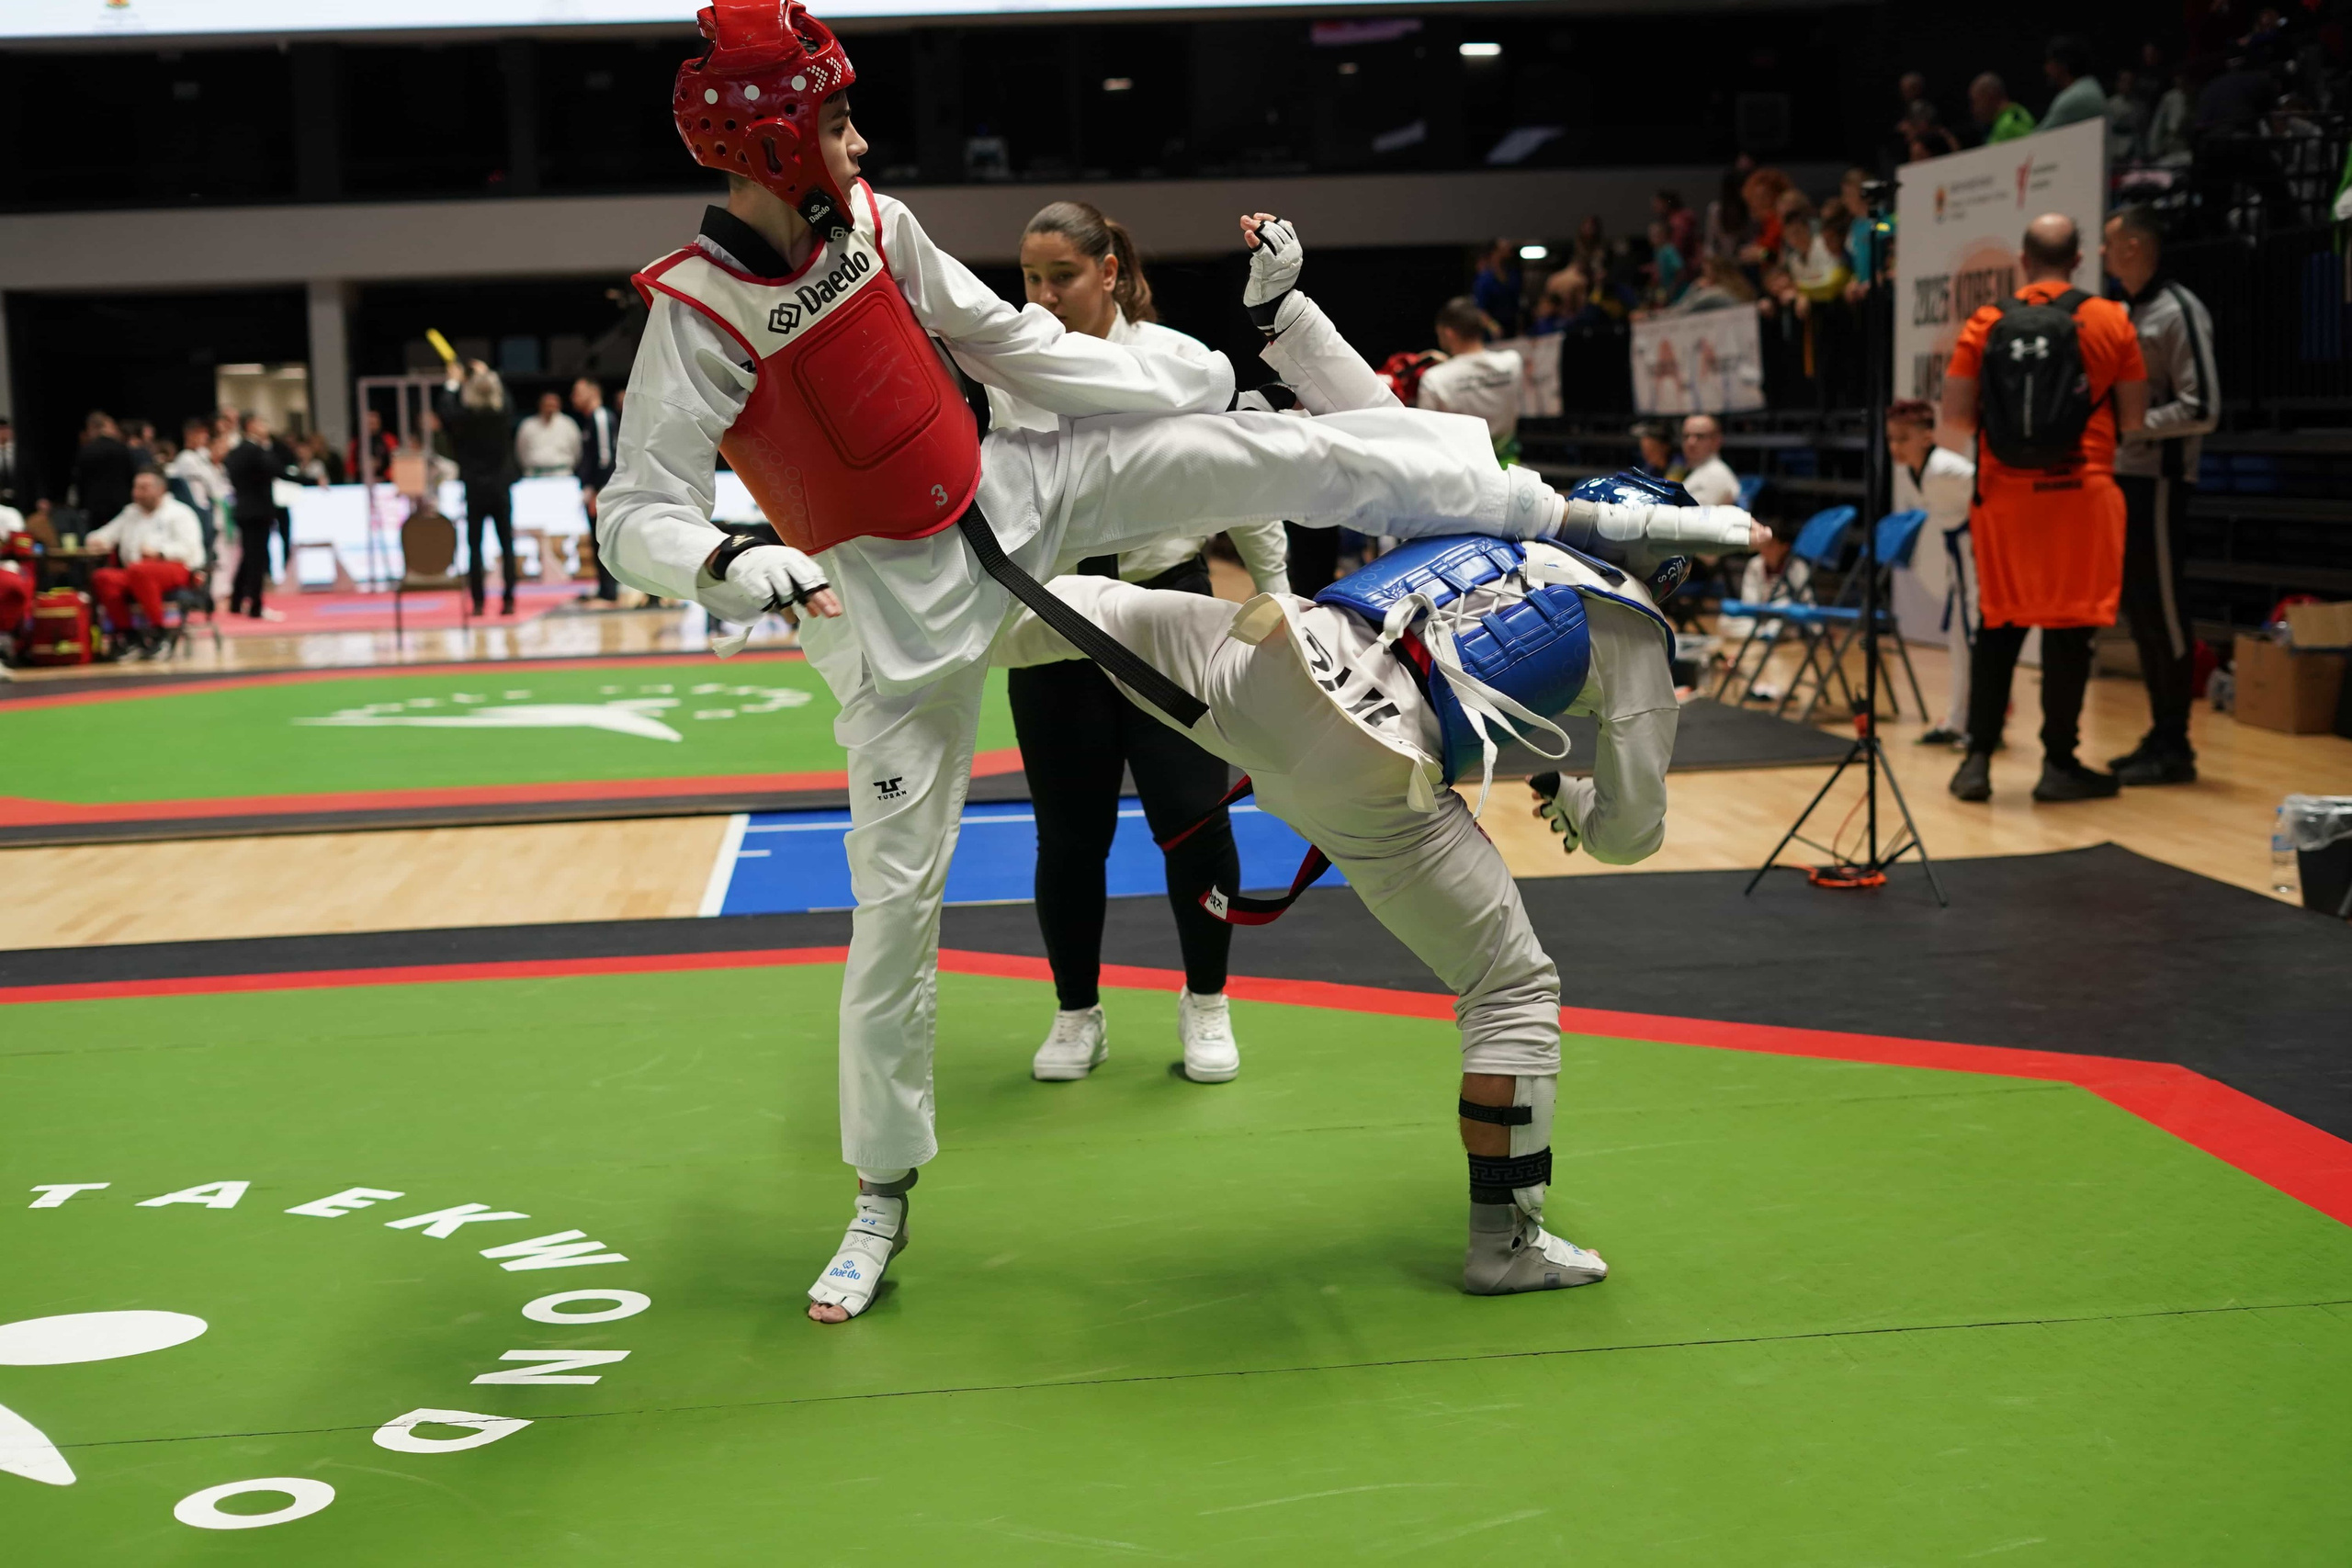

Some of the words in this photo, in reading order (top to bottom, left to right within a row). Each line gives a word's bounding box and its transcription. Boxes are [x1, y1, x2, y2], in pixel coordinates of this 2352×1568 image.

[808, 205, 831, 224] Daedo
[795, 251, 870, 316] Daedo
[931, 484, 948, 506] 3
[829, 1267, 862, 1280] Daedo
